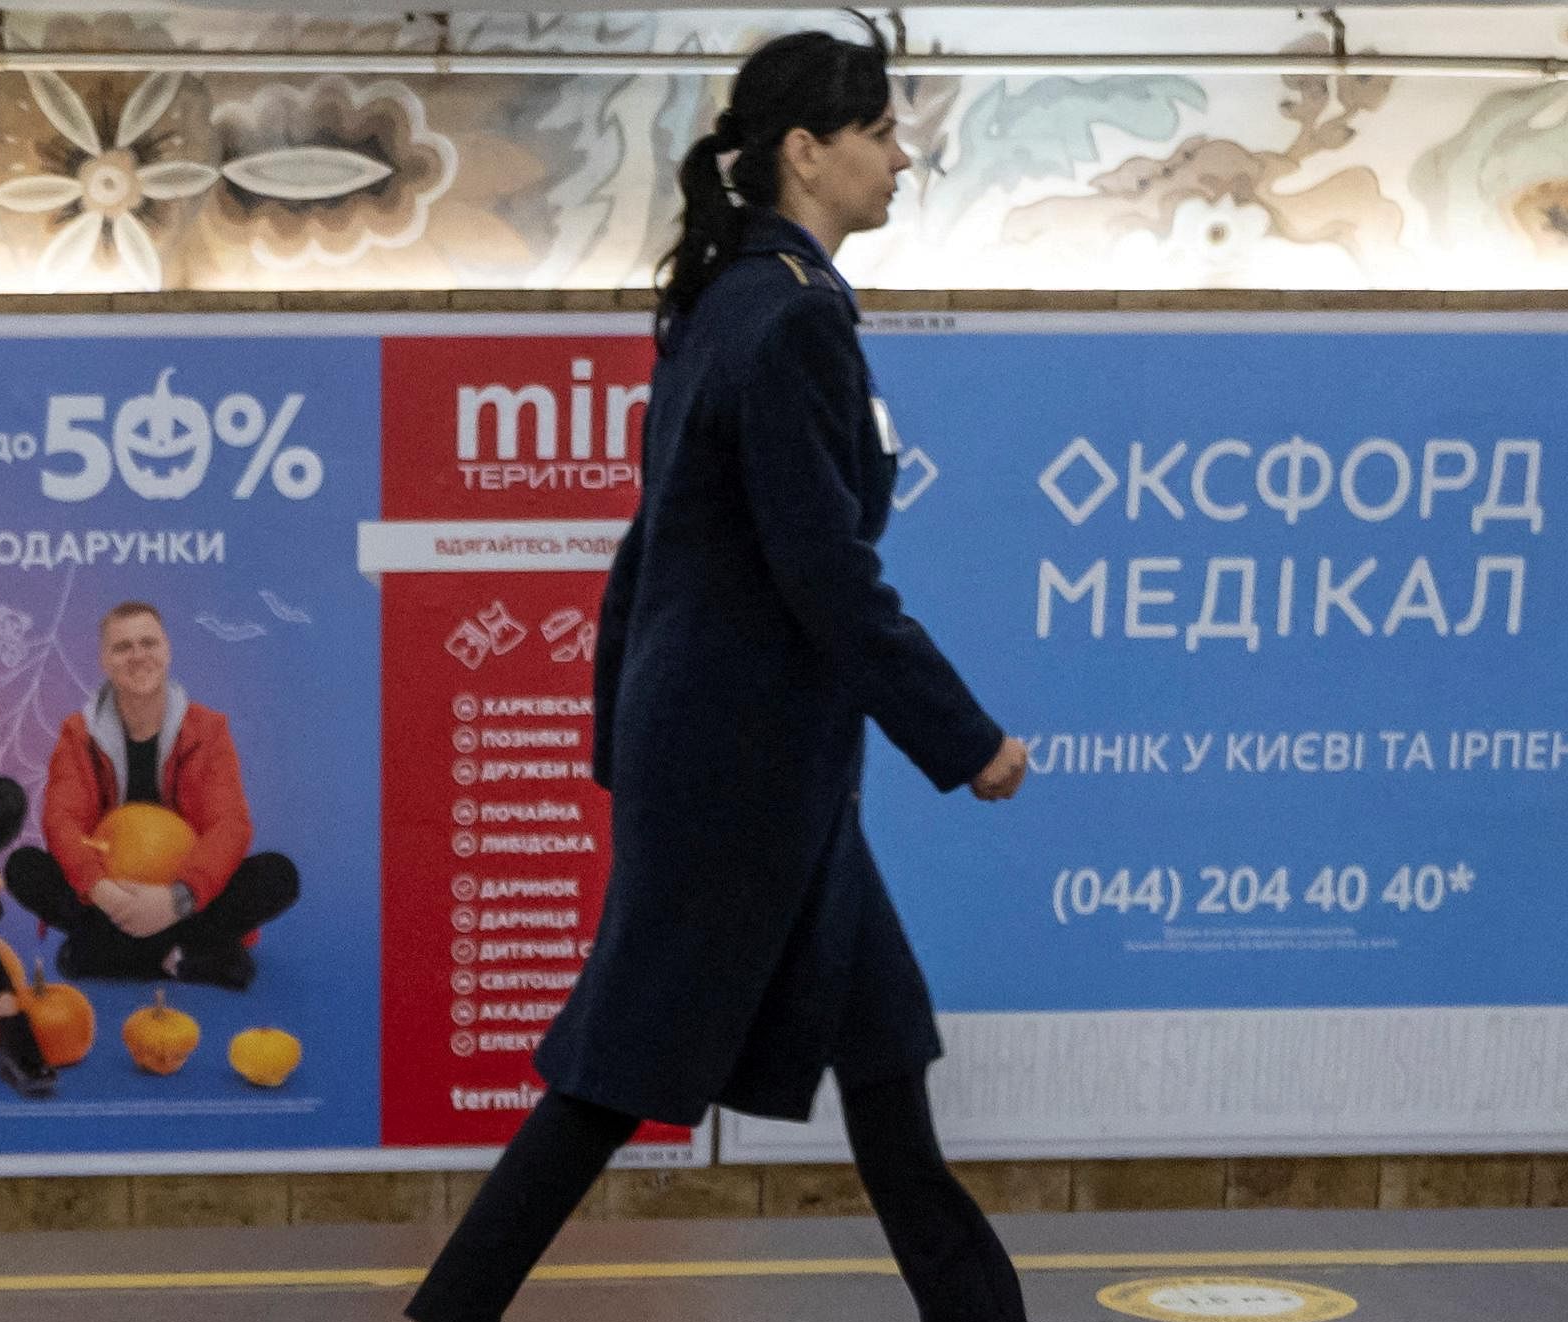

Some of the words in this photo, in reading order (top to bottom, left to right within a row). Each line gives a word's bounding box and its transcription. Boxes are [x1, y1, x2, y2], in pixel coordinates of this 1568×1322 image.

[41, 367, 325, 502] 50%
[1037, 435, 1544, 535] ОКСФОРД
[1036, 556, 1526, 653] МЕДІКАЛ
[1182, 732, 1212, 774] У
[1225, 731, 1364, 773] КИЄВІ
[1379, 730, 1434, 772] ТА
[1052, 867, 1182, 925] (044)
[1196, 866, 1291, 915] 204
[1304, 865, 1369, 914] 40
